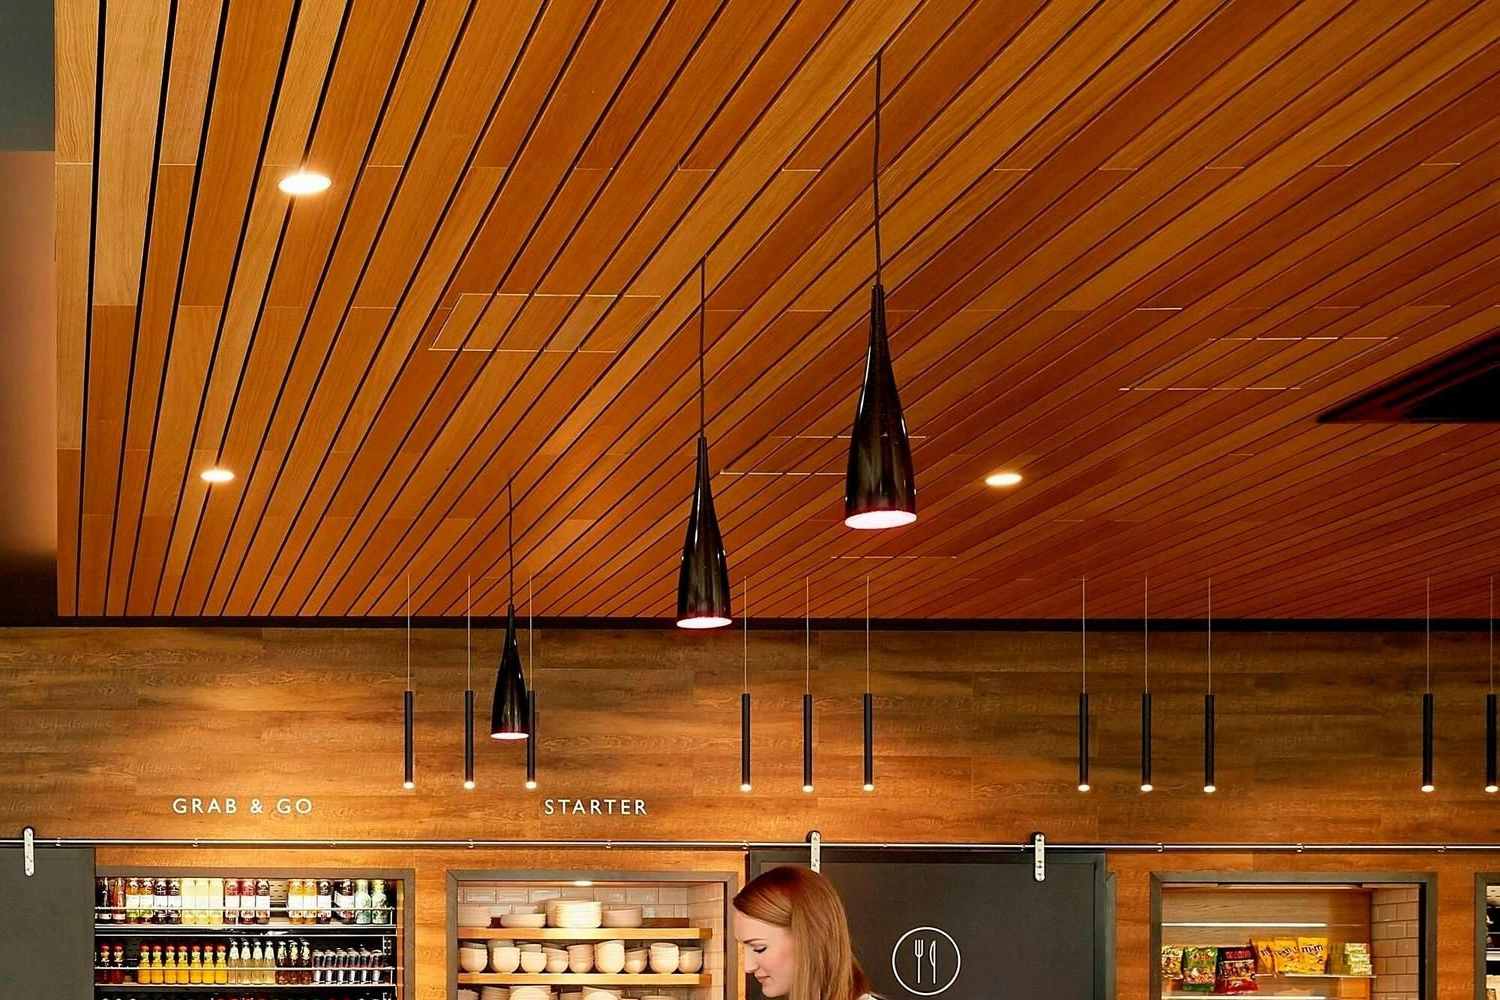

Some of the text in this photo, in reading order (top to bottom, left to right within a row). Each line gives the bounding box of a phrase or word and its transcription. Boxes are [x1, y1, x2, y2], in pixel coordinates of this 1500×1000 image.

[172, 797, 313, 815] GRAB & GO
[544, 798, 648, 816] STARTER
